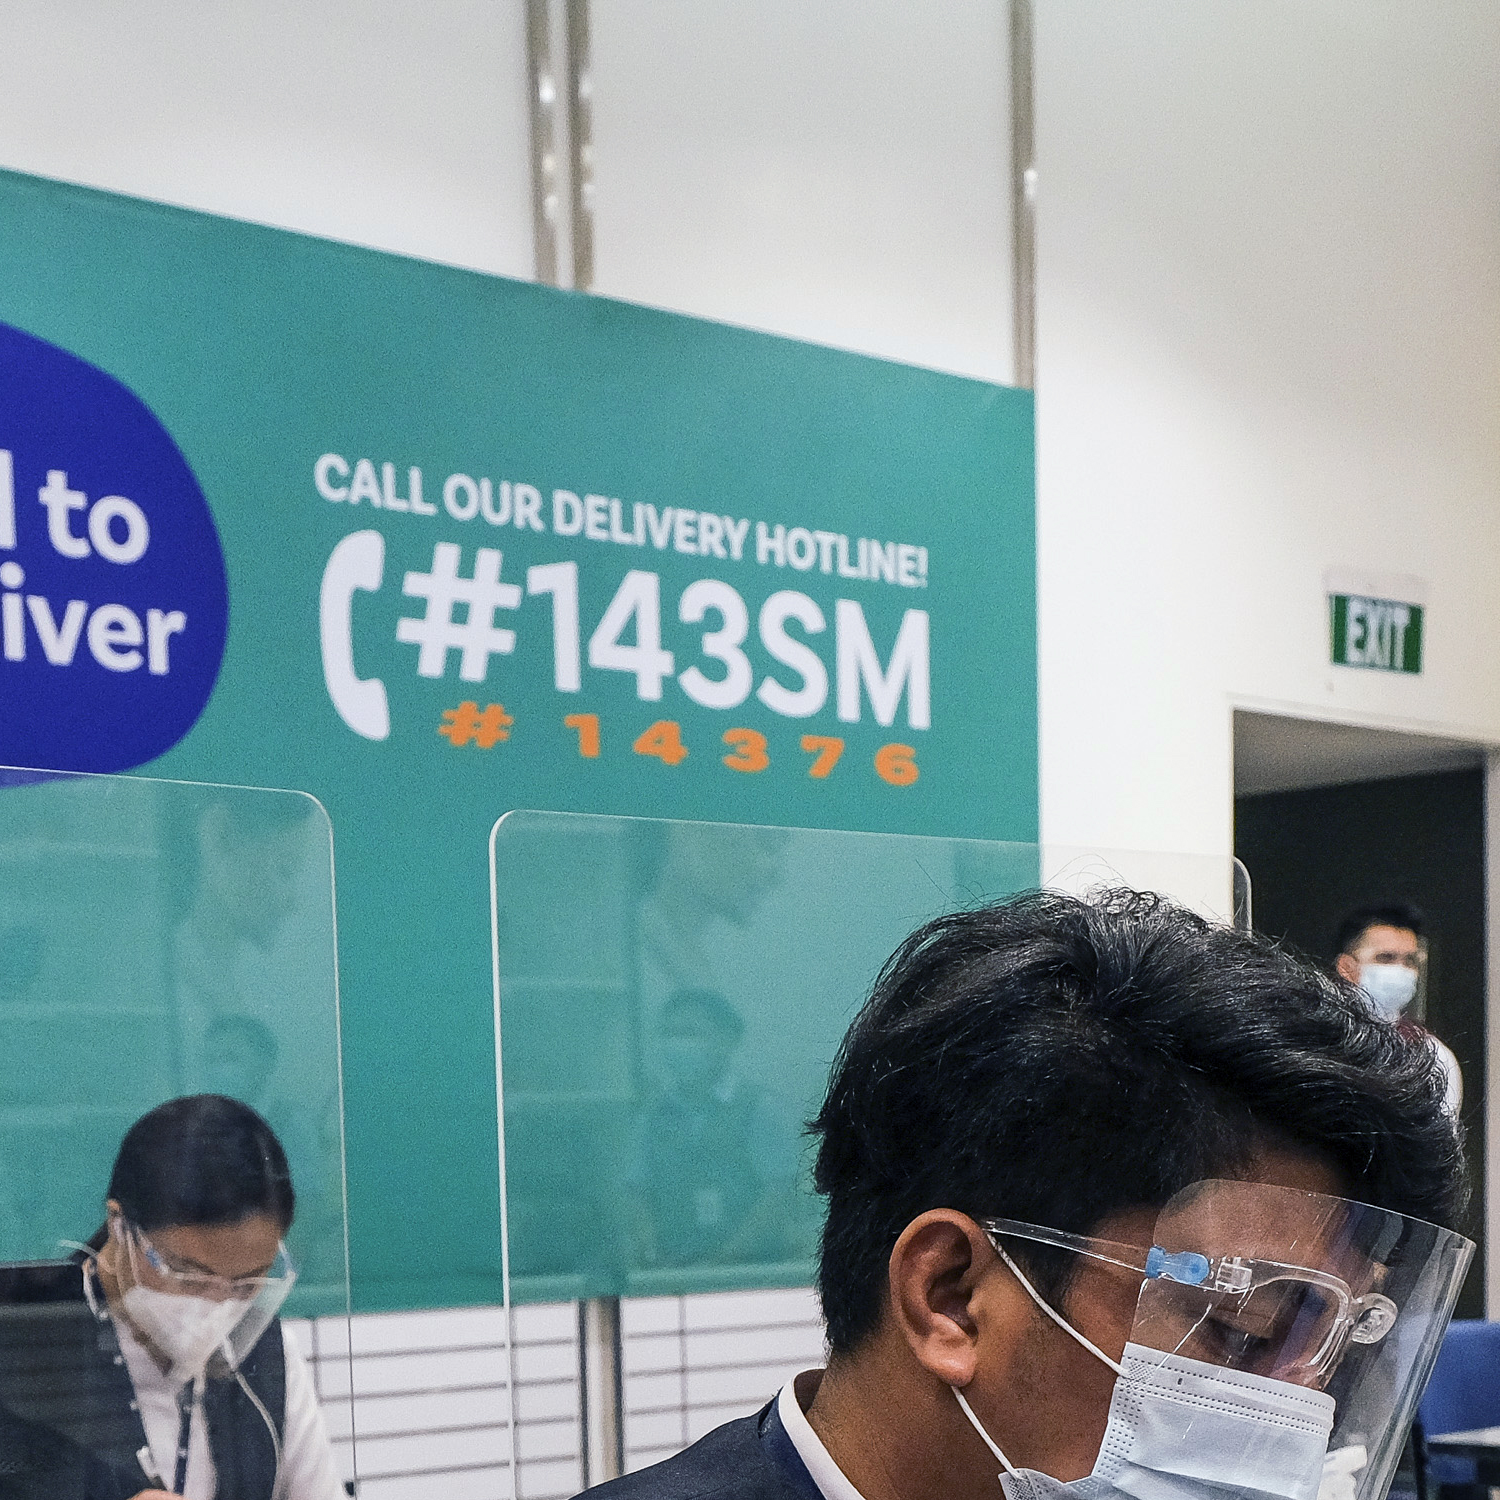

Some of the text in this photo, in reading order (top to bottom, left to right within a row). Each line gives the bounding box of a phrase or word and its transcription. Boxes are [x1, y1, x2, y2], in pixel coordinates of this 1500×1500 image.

[39, 470, 150, 565] to
[314, 453, 929, 588] CALL OUR DELIVERY HOTLINE!
[396, 541, 931, 730] #143SM
[1347, 599, 1411, 669] EXIT
